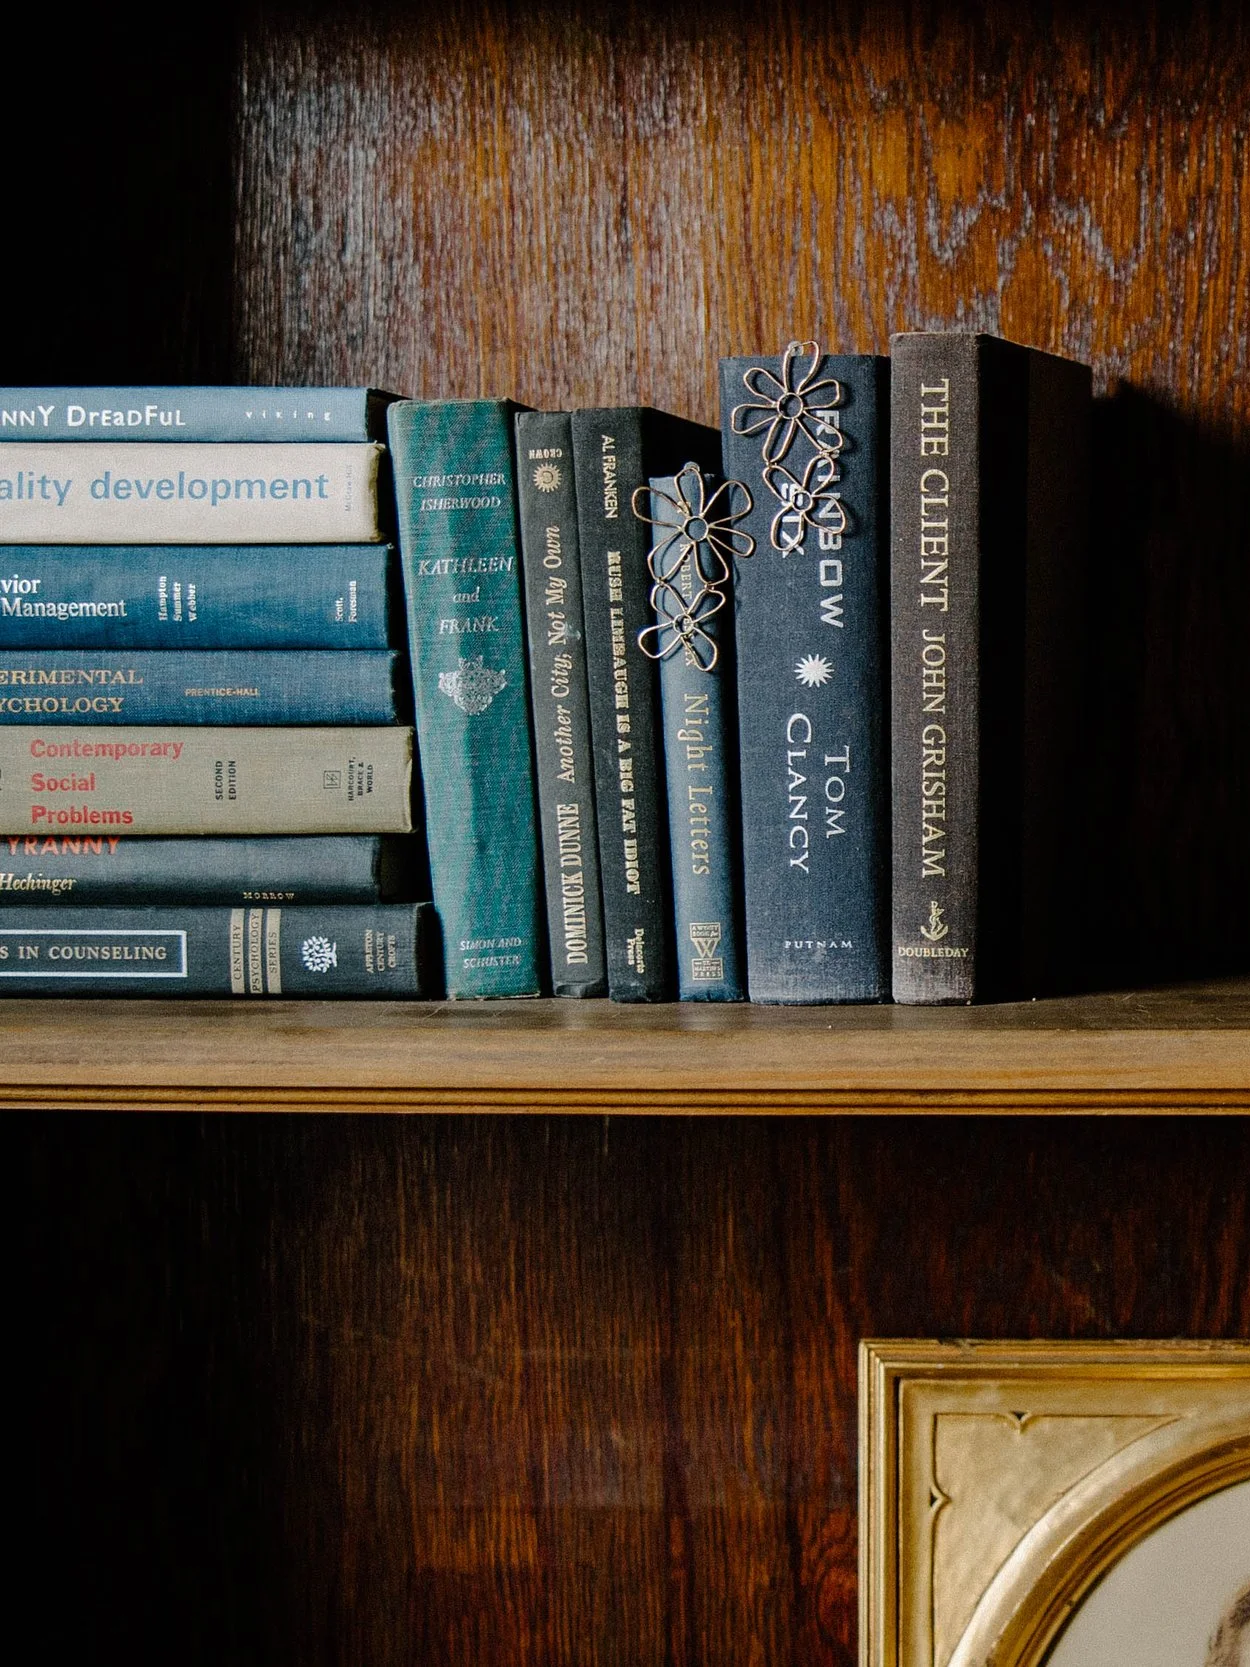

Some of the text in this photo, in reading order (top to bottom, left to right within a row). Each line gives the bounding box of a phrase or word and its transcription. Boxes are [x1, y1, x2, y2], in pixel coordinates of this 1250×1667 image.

[528, 448, 563, 460] CROWN
[0, 470, 329, 506] ality development
[413, 472, 506, 488] CHRISTOPHER
[601, 434, 618, 519] AL FRANKEN
[420, 497, 502, 511] ISHERWOOD
[418, 556, 514, 576] KATHLEEN
[0, 573, 41, 594] vior
[453, 586, 481, 604] and
[2, 597, 128, 621] Management
[157, 576, 168, 621] Hampton
[172, 581, 183, 622] Summer
[187, 583, 197, 622] Webber
[348, 580, 357, 623] Foresman
[439, 616, 500, 635] FRANK
[920, 378, 950, 879] THE CLIENT JOHN GRISHAM
[543, 525, 576, 783] Another City, Not My Own
[0, 669, 144, 685] ERIMENTAL
[185, 688, 260, 697] PRENTICE-HALL
[607, 550, 640, 895] RUSH LIMBAUGH IS A BIG FAT IDIOT
[31, 739, 184, 760] Contemporary
[31, 772, 96, 792] Social
[215, 760, 223, 801] SECOND
[228, 760, 236, 801] EDITION
[356, 770, 364, 796] BRACE
[677, 693, 713, 876] Night Letters
[786, 712, 812, 874] CLANCY
[824, 745, 850, 839] TOM
[31, 805, 133, 824] Problems
[0, 872, 77, 896] Hechinger
[243, 891, 295, 900] MORROW
[556, 802, 588, 965] DOMINICK DUNNE
[18, 946, 39, 960] IN
[48, 945, 167, 960] COUNSELING
[232, 924, 242, 980] CENTURY
[250, 912, 261, 992] PSYCHOLOGY
[268, 931, 277, 974] SERIES
[365, 929, 374, 974] APPLETON
[376, 931, 385, 972] CENTURY
[460, 936, 522, 951] SIMON AND
[627, 938, 636, 966] Press
[785, 940, 853, 949] PUTNAM
[898, 947, 969, 958] DOUBLEDAY
[463, 954, 521, 969] SCHUSTER
